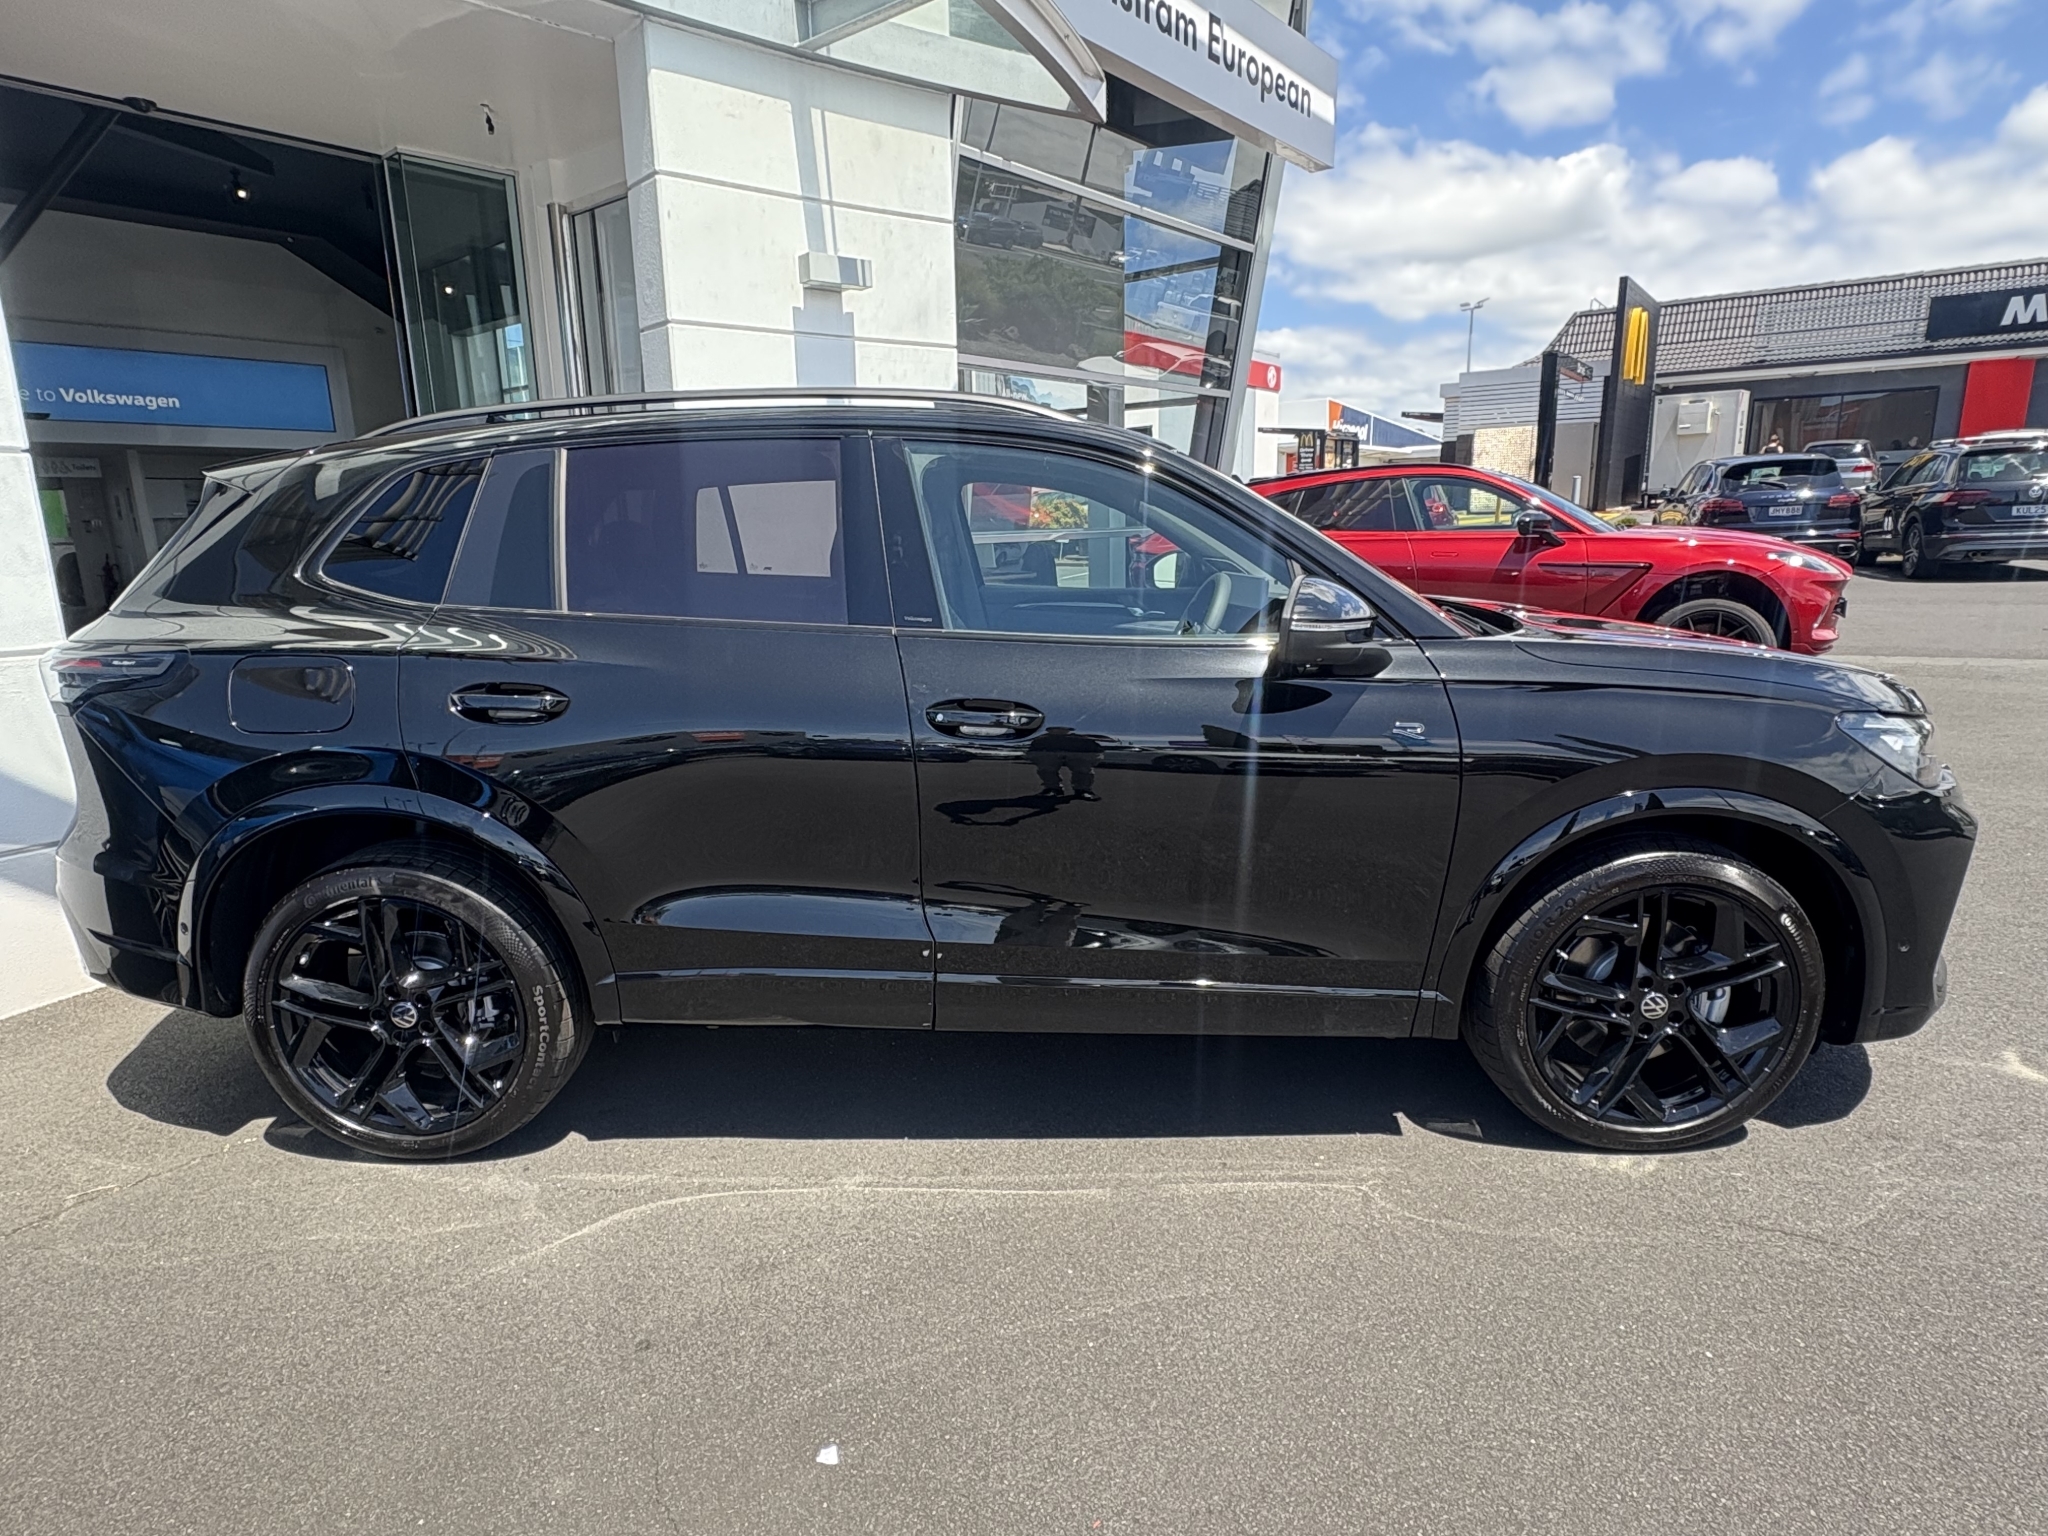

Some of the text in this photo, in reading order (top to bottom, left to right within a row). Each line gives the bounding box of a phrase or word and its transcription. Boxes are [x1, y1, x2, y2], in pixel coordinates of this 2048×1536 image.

[1208, 11, 1312, 118] European
[36, 388, 56, 402] to
[59, 387, 181, 411] Volkswagen
